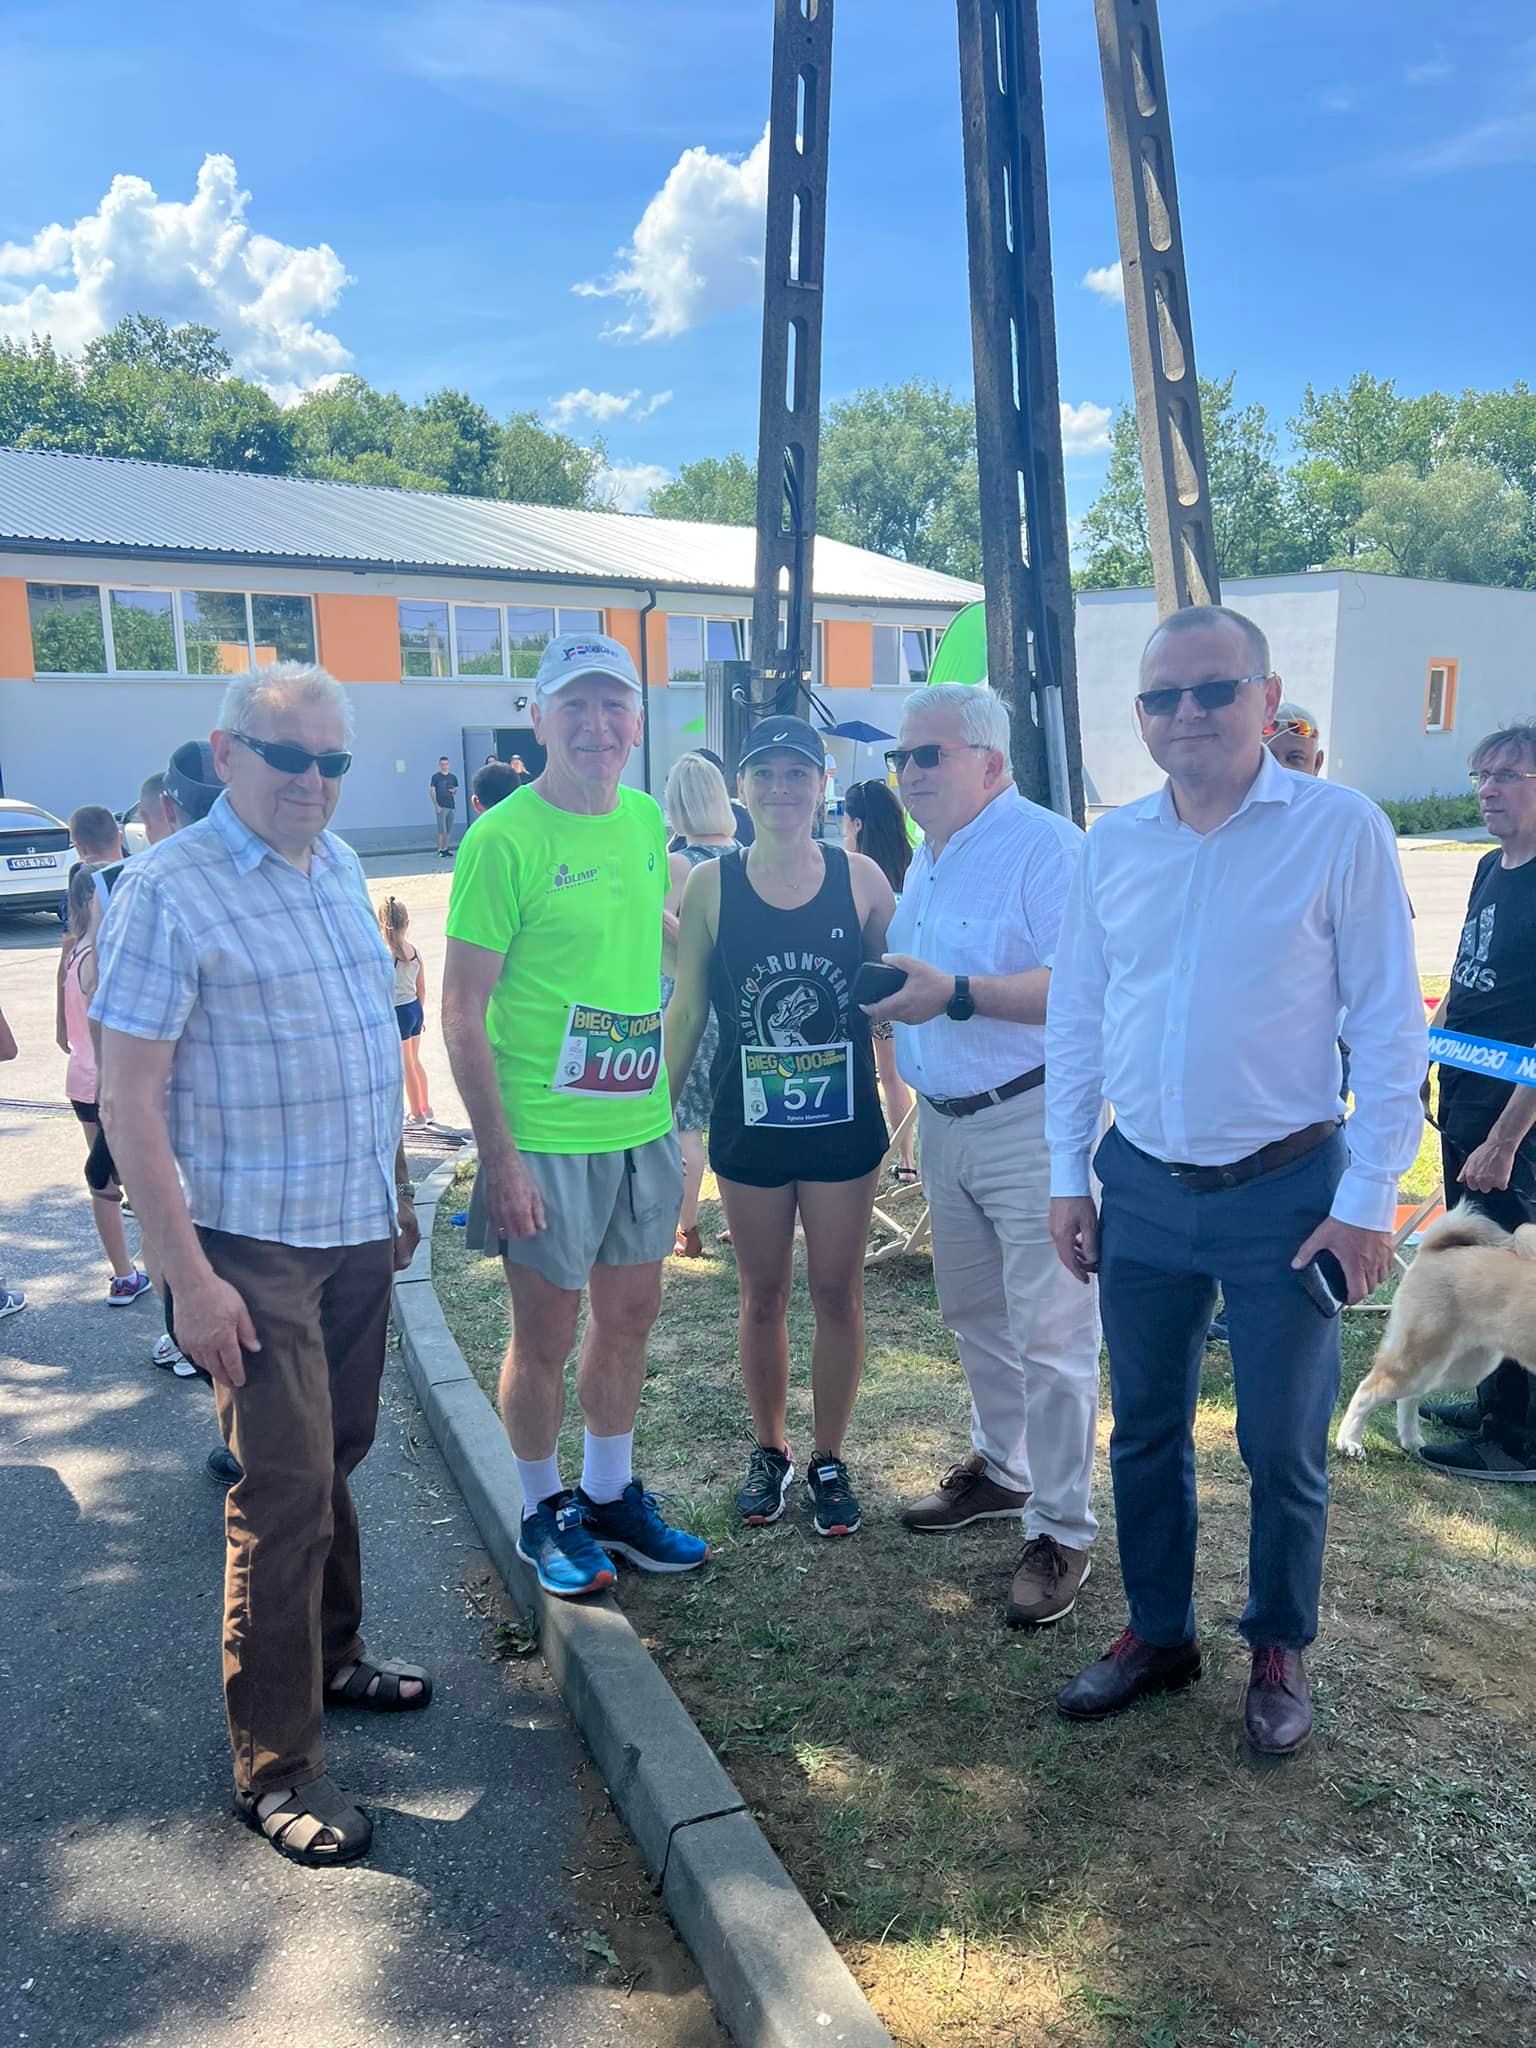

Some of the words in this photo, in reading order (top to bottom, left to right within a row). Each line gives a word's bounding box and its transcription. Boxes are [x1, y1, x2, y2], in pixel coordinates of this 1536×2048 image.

[564, 868, 597, 885] OLIMP
[766, 951, 814, 975] RUN
[820, 957, 849, 1010] TEAM
[574, 1010, 612, 1031] BIEG
[629, 1016, 650, 1037] 100
[595, 1046, 656, 1081] 100
[746, 1054, 777, 1072] BIEG
[796, 1051, 822, 1073] 100
[1427, 1035, 1509, 1070] DECATHLON
[783, 1075, 832, 1110] 57
